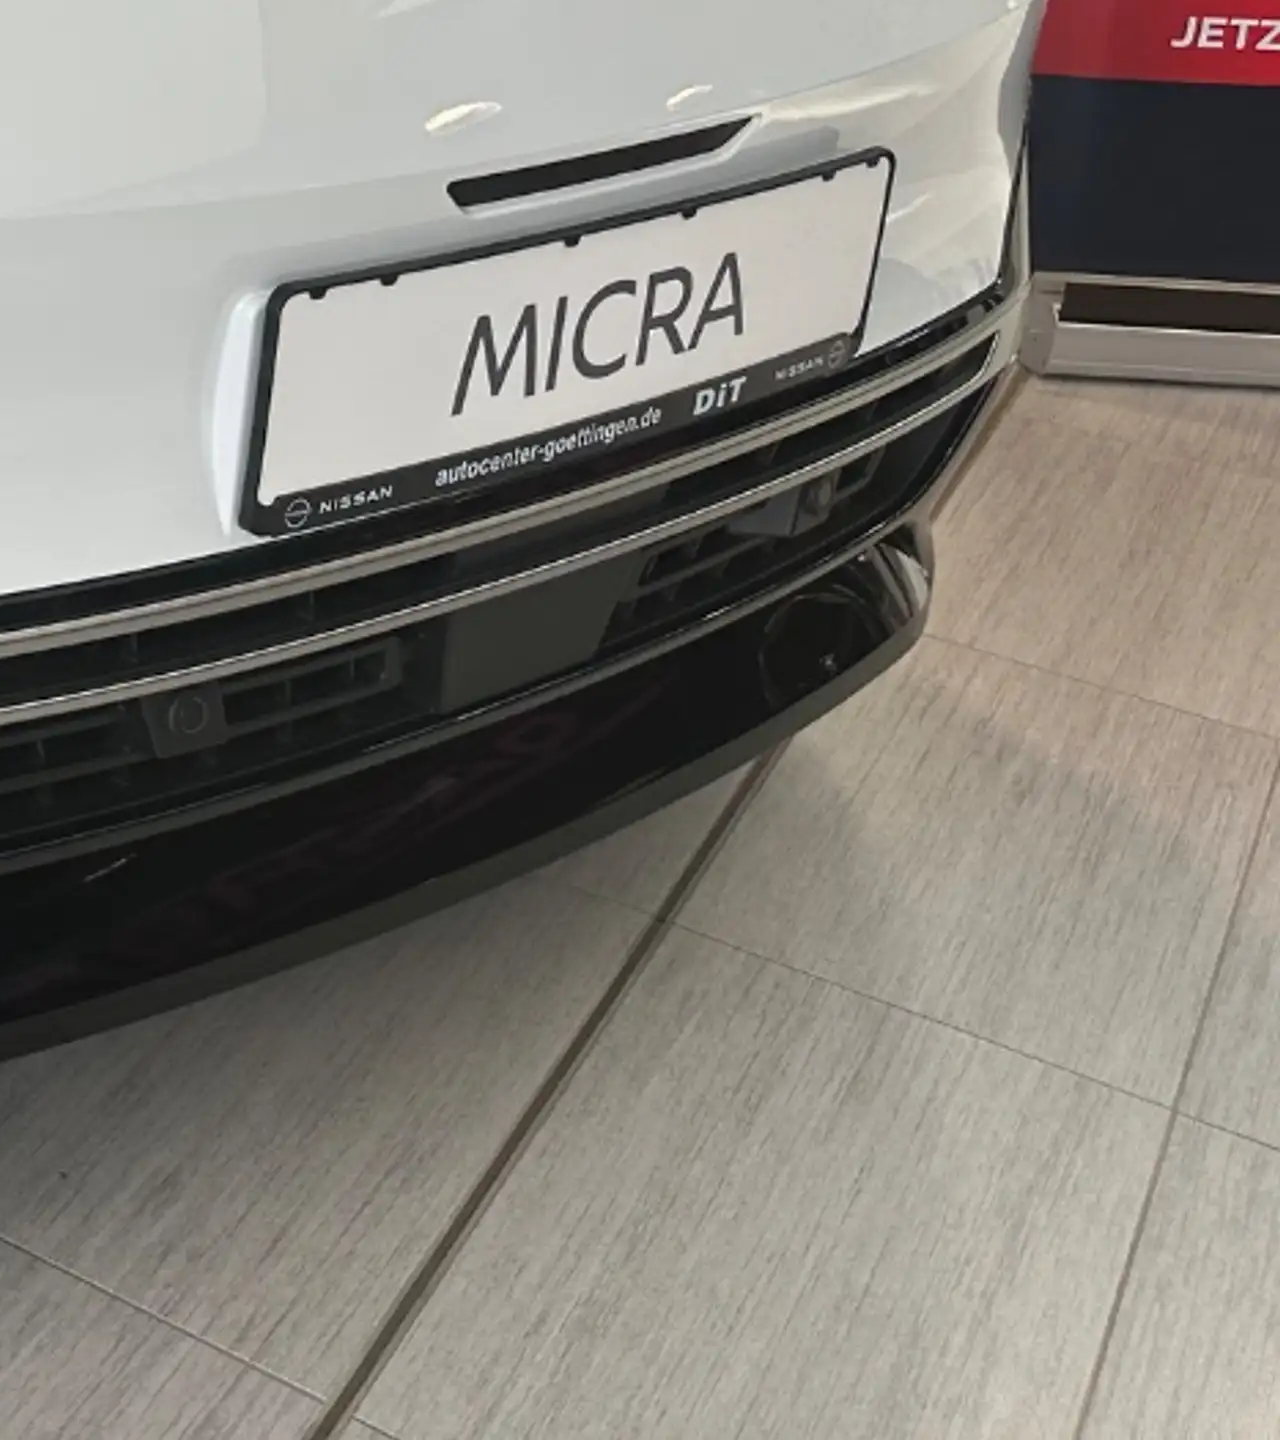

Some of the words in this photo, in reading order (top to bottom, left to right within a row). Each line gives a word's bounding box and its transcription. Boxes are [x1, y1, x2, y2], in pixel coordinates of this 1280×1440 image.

[1170, 16, 1280, 50] JETZ
[451, 252, 743, 417] MICRA
[319, 485, 393, 514] NISSAN
[435, 406, 661, 487] autocenter-goettingen.de
[692, 376, 749, 416] DiT
[774, 356, 824, 380] NISSAN
